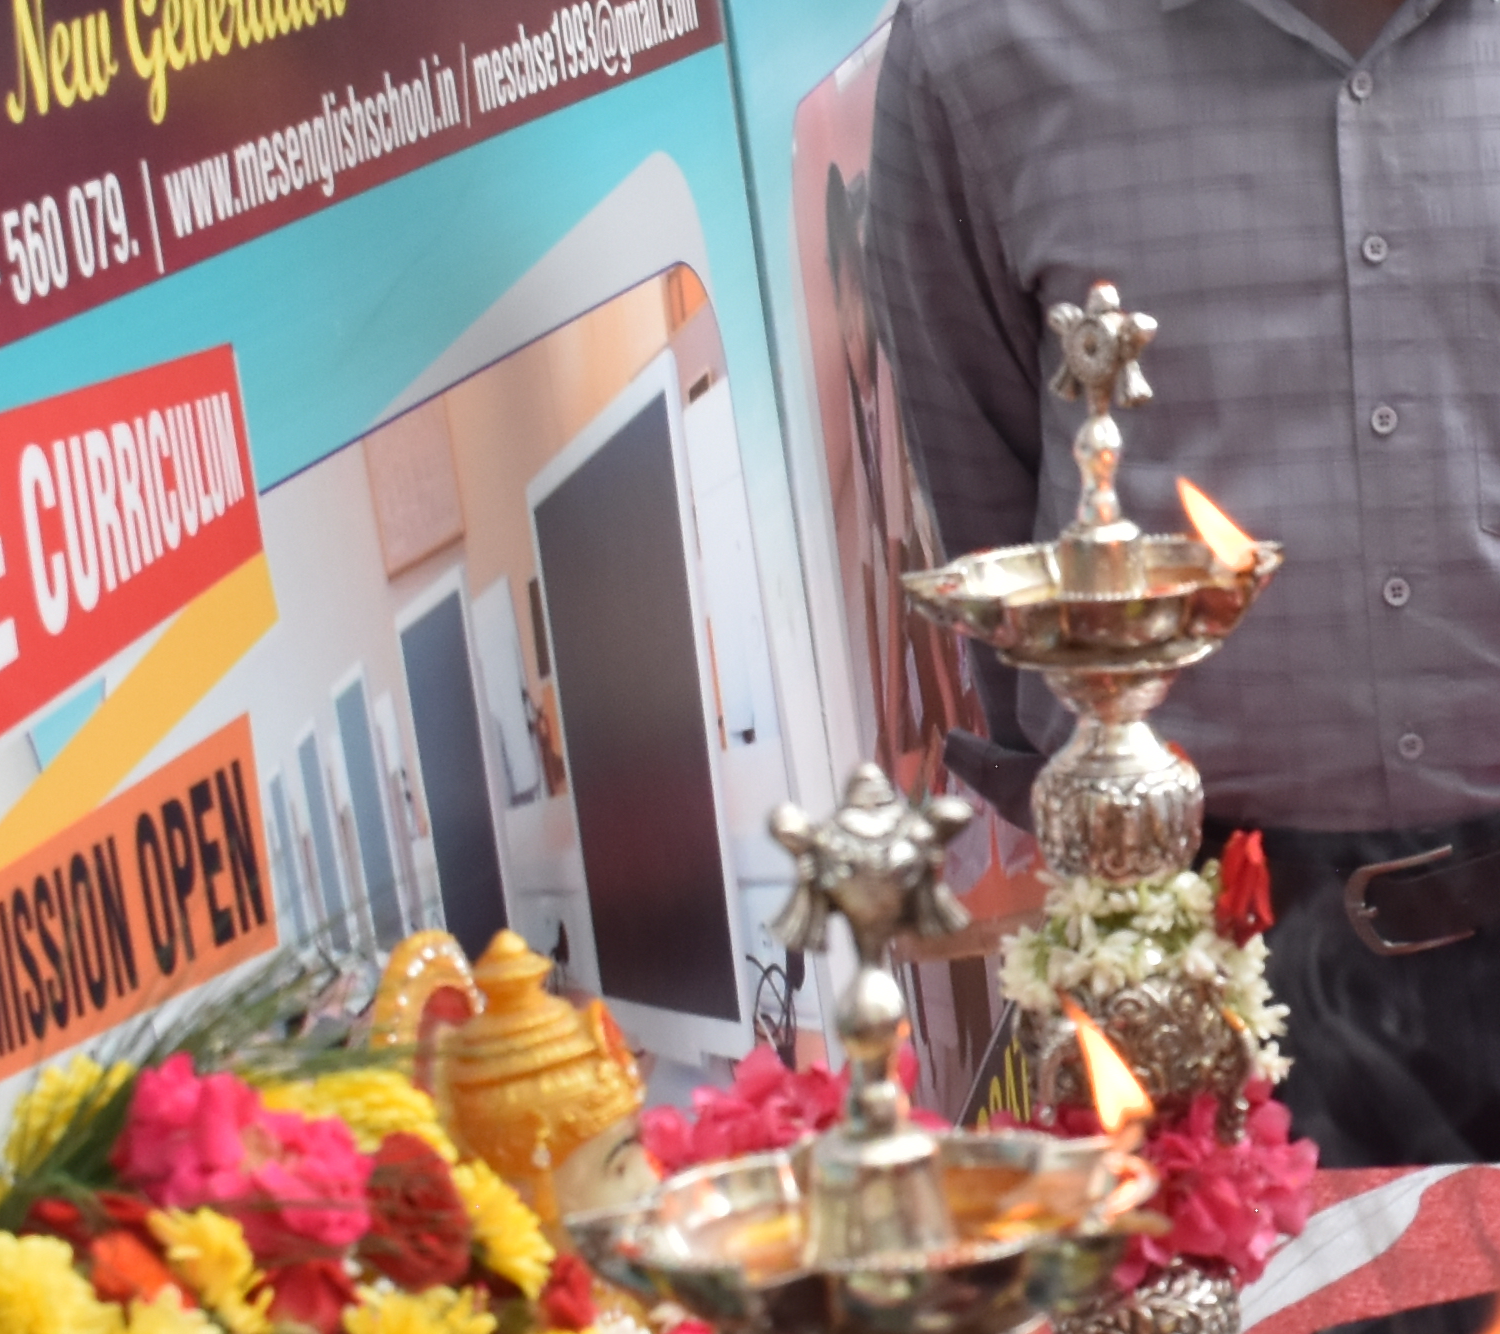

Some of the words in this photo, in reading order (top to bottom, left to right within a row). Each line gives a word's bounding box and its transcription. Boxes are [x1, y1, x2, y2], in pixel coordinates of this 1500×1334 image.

[0, 195, 69, 305] 560
[63, 172, 142, 280] 079.
[162, 53, 462, 240] www.mesenglishschool.in
[18, 390, 247, 639] CURRICULUM
[134, 757, 270, 979] OPEN
